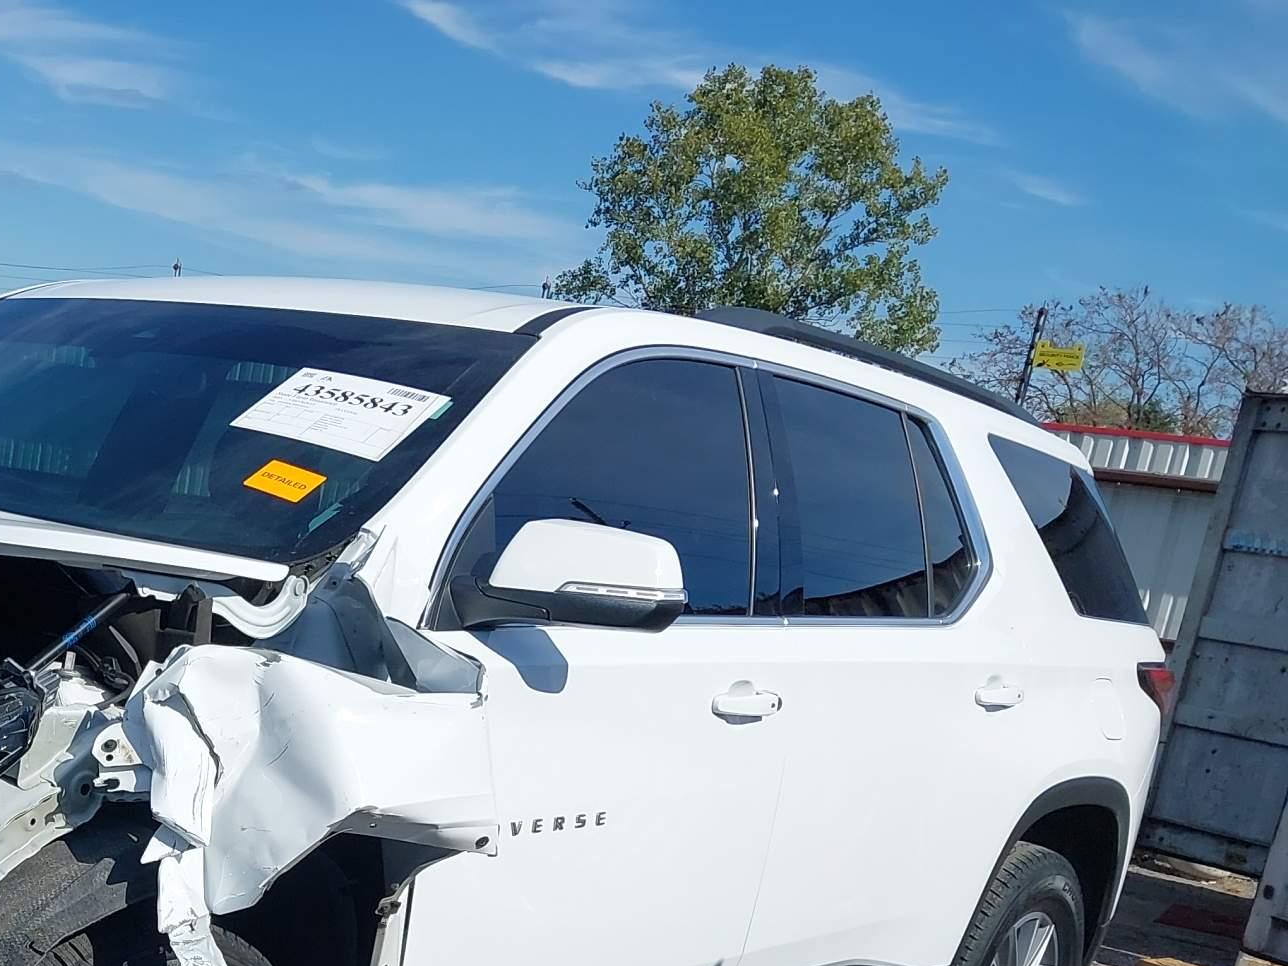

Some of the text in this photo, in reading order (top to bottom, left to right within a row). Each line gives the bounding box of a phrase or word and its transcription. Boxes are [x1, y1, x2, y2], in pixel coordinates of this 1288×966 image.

[293, 384, 413, 416] 43585843
[261, 471, 307, 491] DETAILED
[510, 812, 607, 836] VERSE
